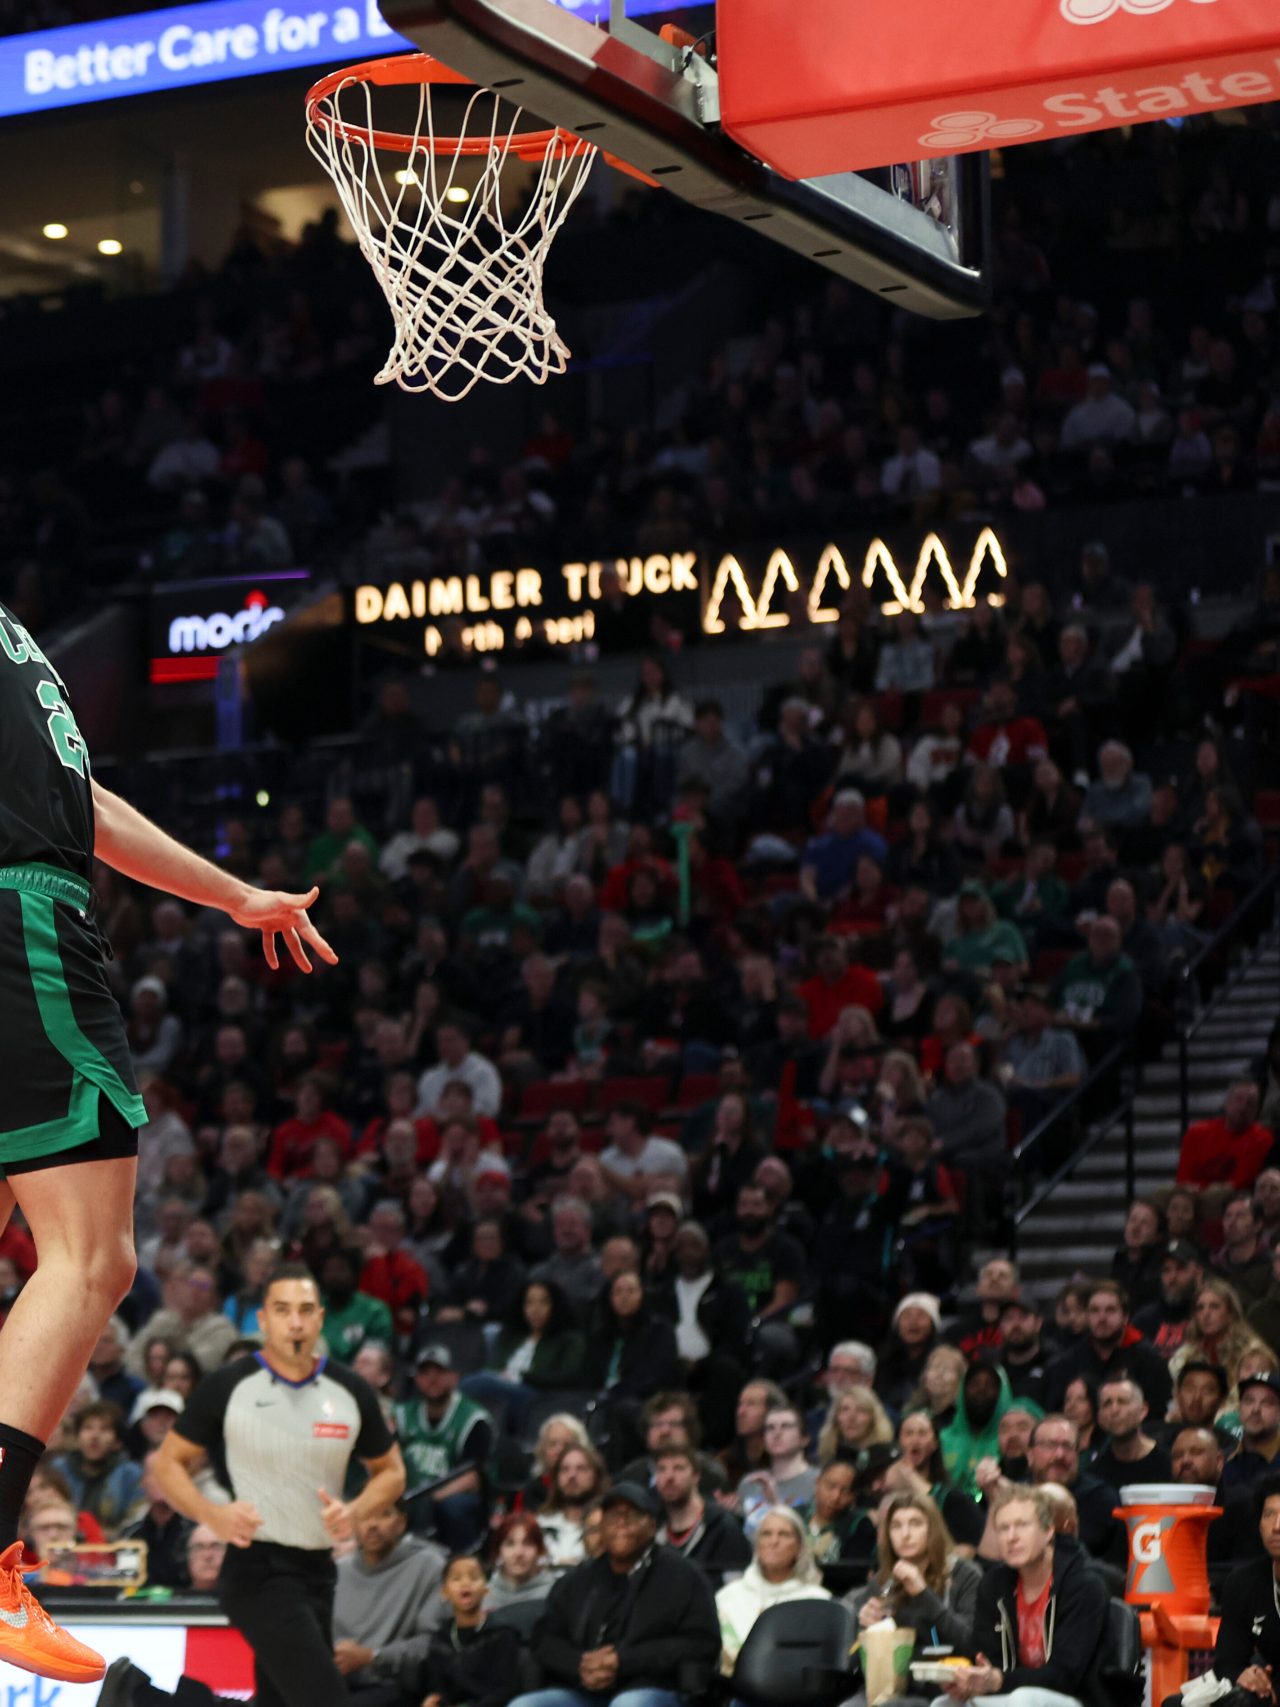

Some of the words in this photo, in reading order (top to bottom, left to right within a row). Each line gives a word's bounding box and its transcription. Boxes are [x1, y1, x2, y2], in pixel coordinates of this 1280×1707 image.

[24, 40, 155, 95] Better
[158, 24, 259, 71] Care
[263, 8, 328, 55] for
[331, 7, 360, 44] a
[1042, 70, 1274, 128] State
[354, 567, 544, 624] DAIMLER
[1132, 1521, 1162, 1564] G
